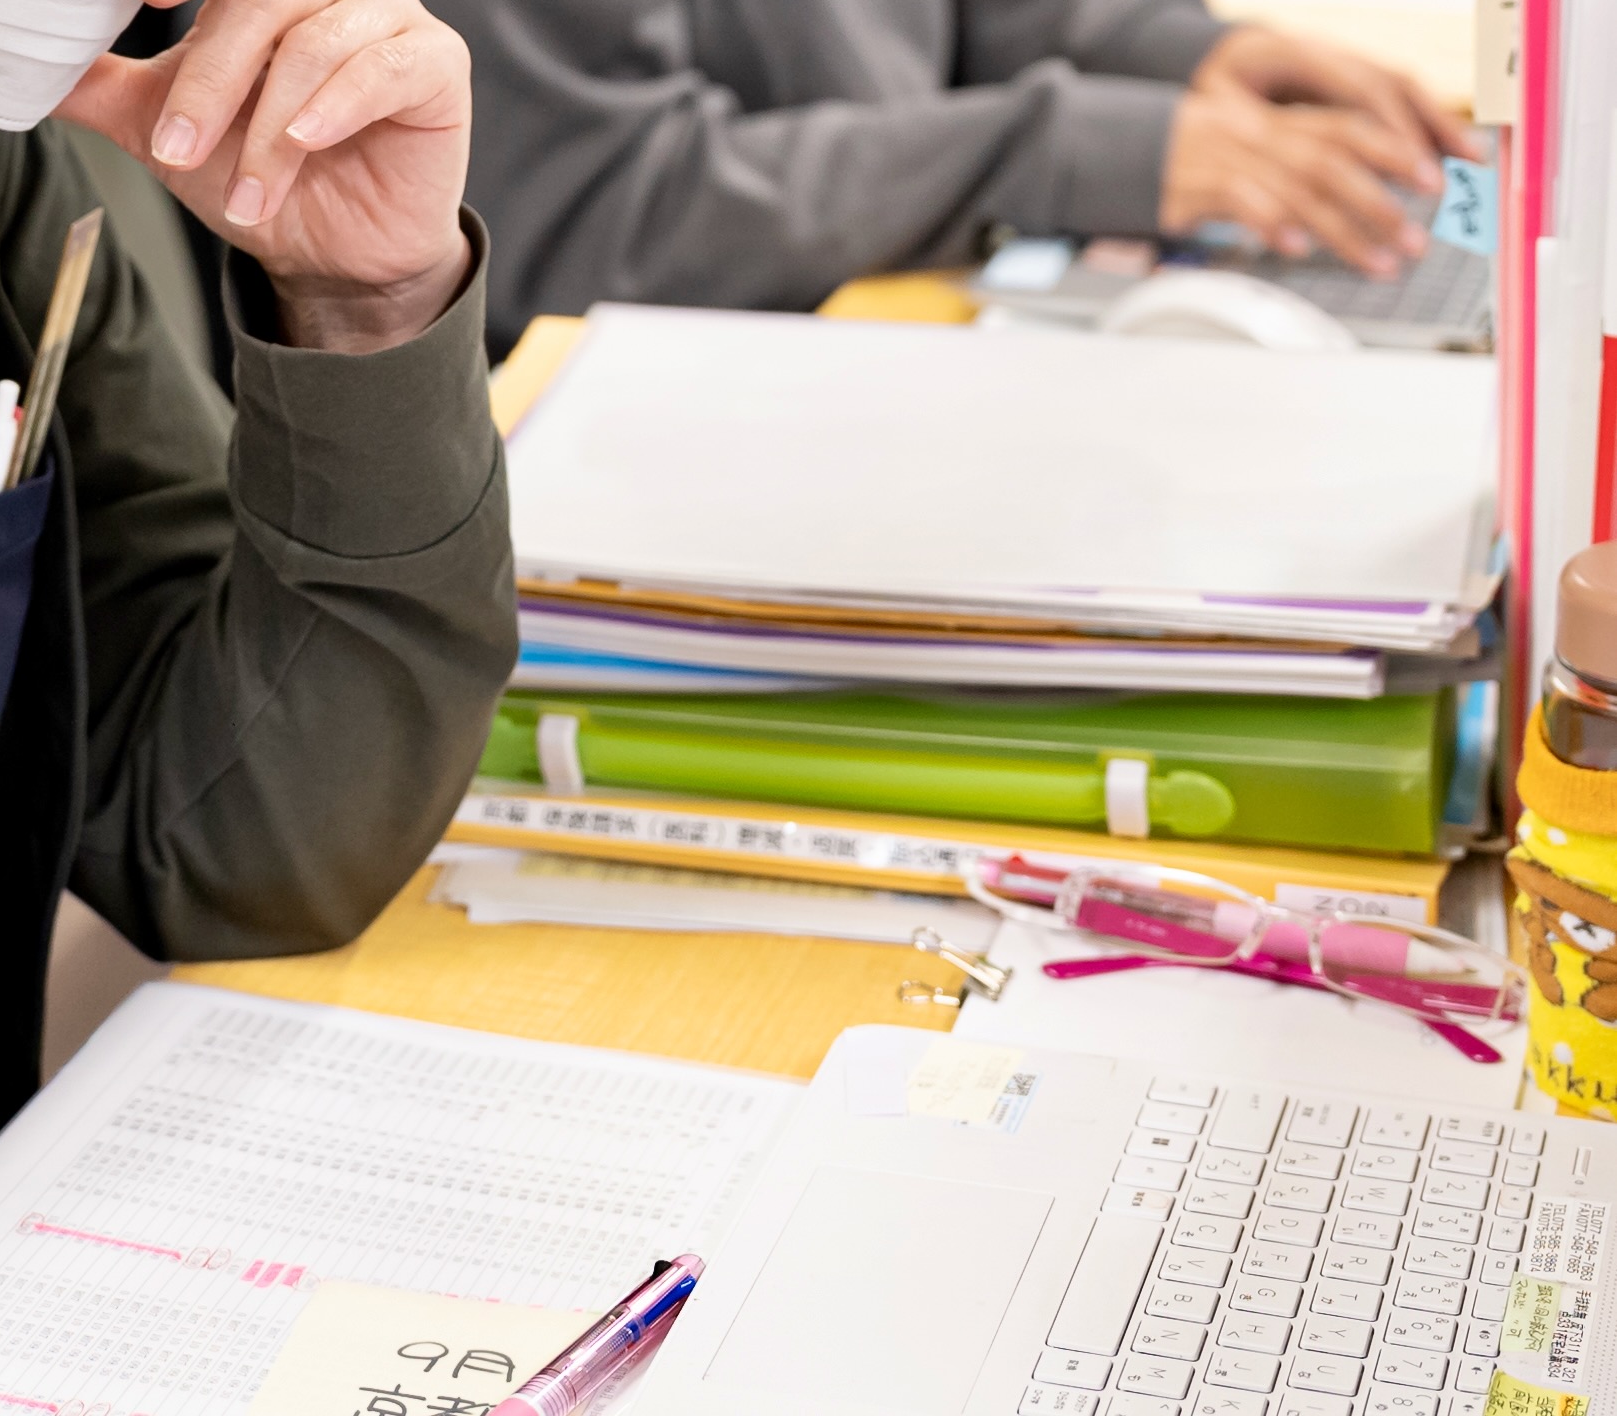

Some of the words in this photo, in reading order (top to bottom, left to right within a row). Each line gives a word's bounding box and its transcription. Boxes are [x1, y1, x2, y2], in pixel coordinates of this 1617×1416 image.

[1303, 1152, 1319, 1162] A
[1376, 1155, 1396, 1165] Q
[1222, 1158, 1242, 1169] Z
[1290, 1185, 1309, 1195] S
[1446, 1182, 1467, 1191] 2
[1210, 1190, 1228, 1200] X
[1367, 1187, 1386, 1199] W
[1280, 1218, 1299, 1227] D
[1438, 1216, 1459, 1225] 3
[1198, 1225, 1217, 1234] C
[1357, 1222, 1377, 1231] E
[1271, 1253, 1288, 1263] F
[1431, 1250, 1449, 1260] 4
[1186, 1259, 1205, 1269] V
[1350, 1256, 1368, 1266] R
[1257, 1287, 1277, 1298] G
[1420, 1285, 1441, 1295] 5
[1173, 1293, 1193, 1303] B
[1339, 1292, 1358, 1301] T
[1245, 1324, 1265, 1334] H
[1411, 1322, 1432, 1331] 6
[1160, 1329, 1180, 1341] N
[1328, 1329, 1347, 1338] Y
[397, 1341, 516, 1383] 9月
[1234, 1362, 1252, 1371] J
[1403, 1359, 1423, 1369] 7
[1147, 1367, 1167, 1378] M
[1317, 1365, 1337, 1375] U
[1221, 1399, 1242, 1410] K
[1392, 1396, 1413, 1407] 8
